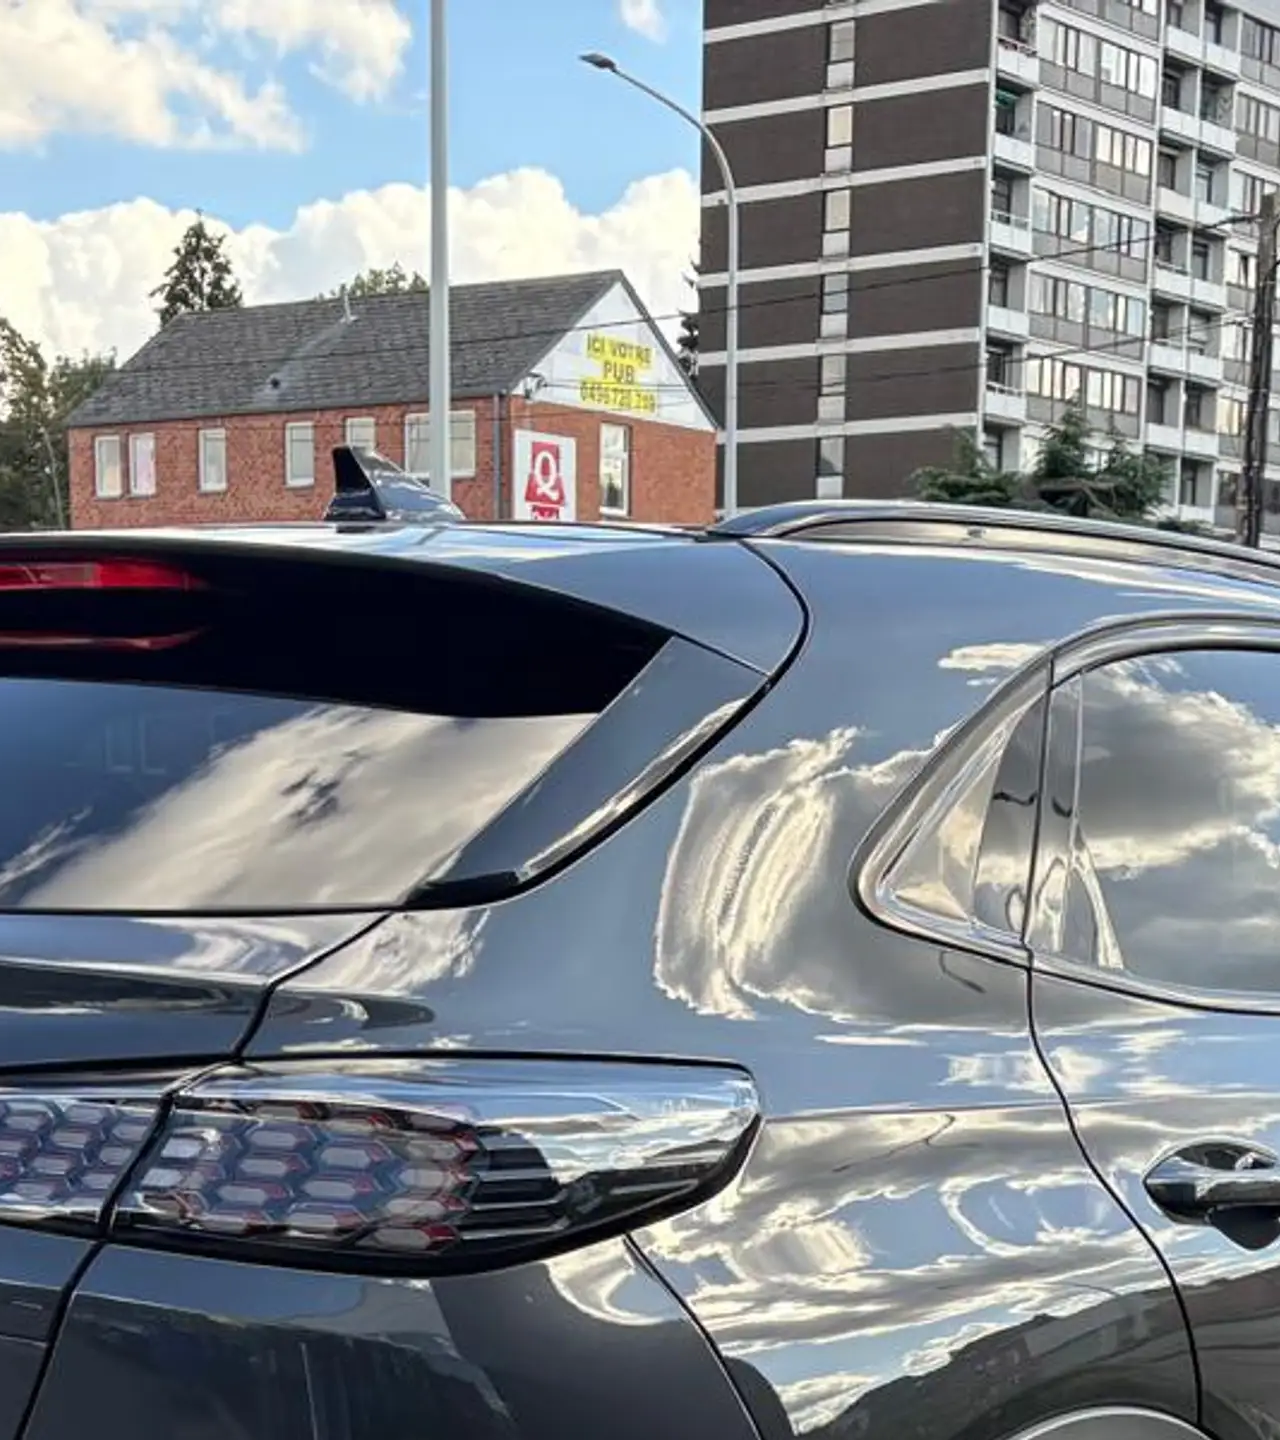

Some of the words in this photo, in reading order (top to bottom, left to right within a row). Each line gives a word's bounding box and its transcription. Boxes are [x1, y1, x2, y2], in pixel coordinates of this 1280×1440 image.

[609, 340, 651, 364] VOTRE
[603, 360, 635, 385] PUB
[534, 450, 560, 501] Q
